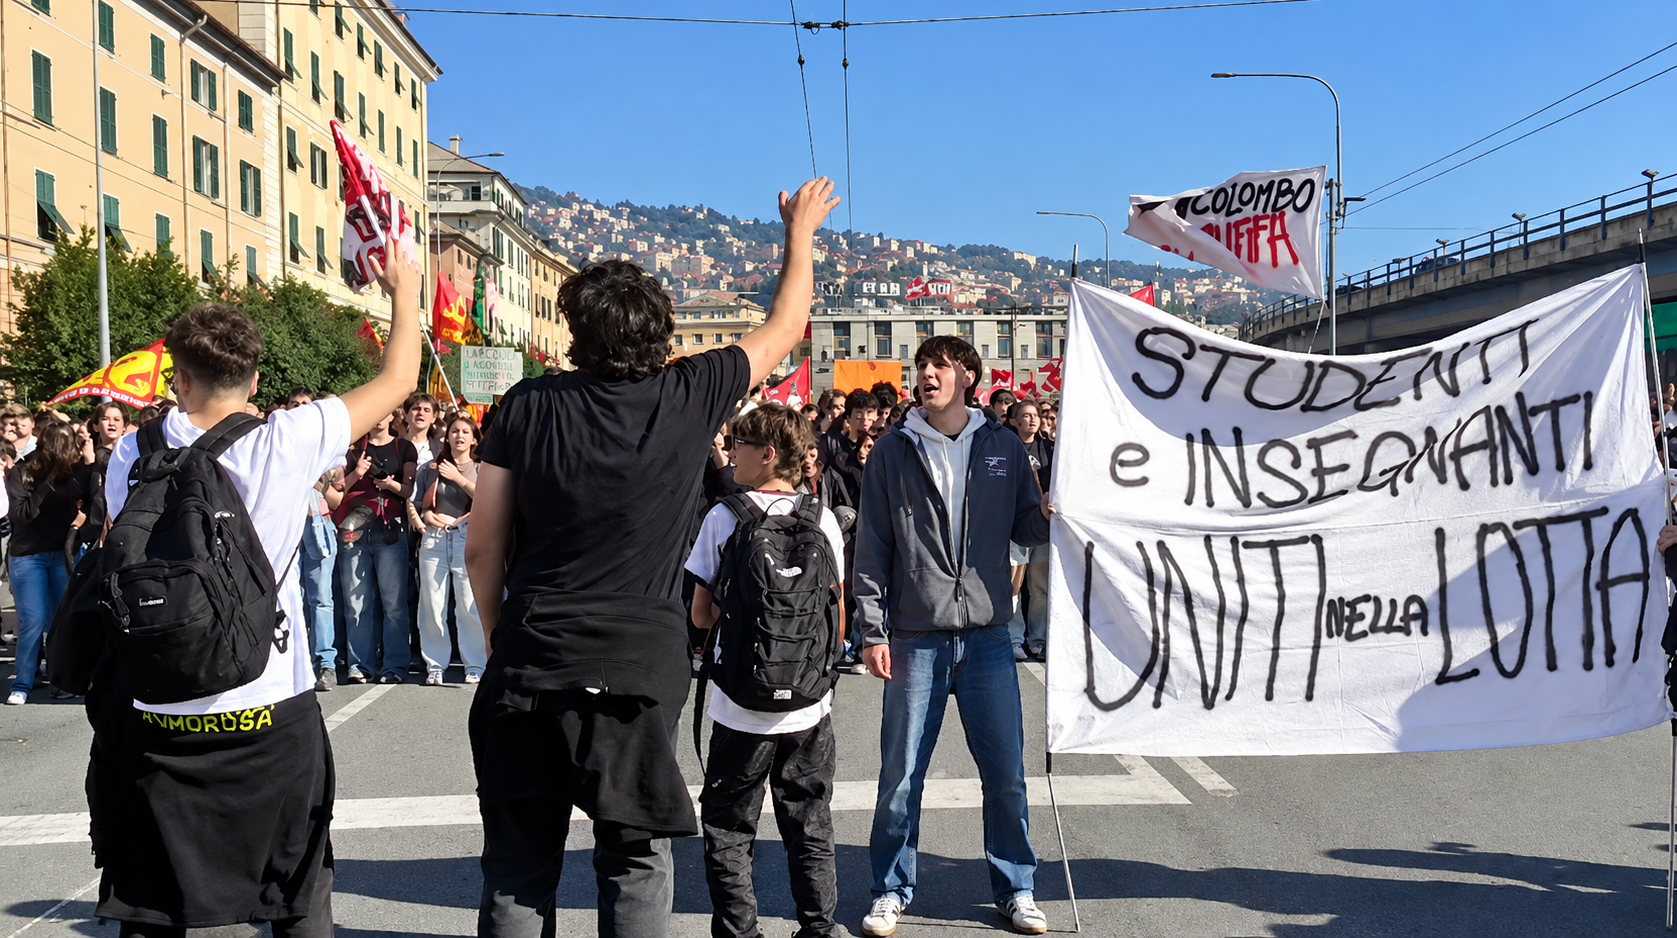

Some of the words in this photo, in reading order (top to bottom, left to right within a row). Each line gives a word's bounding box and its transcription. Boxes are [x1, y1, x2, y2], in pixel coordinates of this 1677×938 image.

[1190, 178, 1316, 217] COLOMBO
[1132, 319, 1539, 412] STUDENTI
[1110, 441, 1151, 488] e
[1183, 391, 1594, 509] INSEGNANTI
[1083, 534, 1325, 712] UNITI
[1325, 595, 1430, 642] NELLA
[1435, 506, 1650, 686] LOTTA
